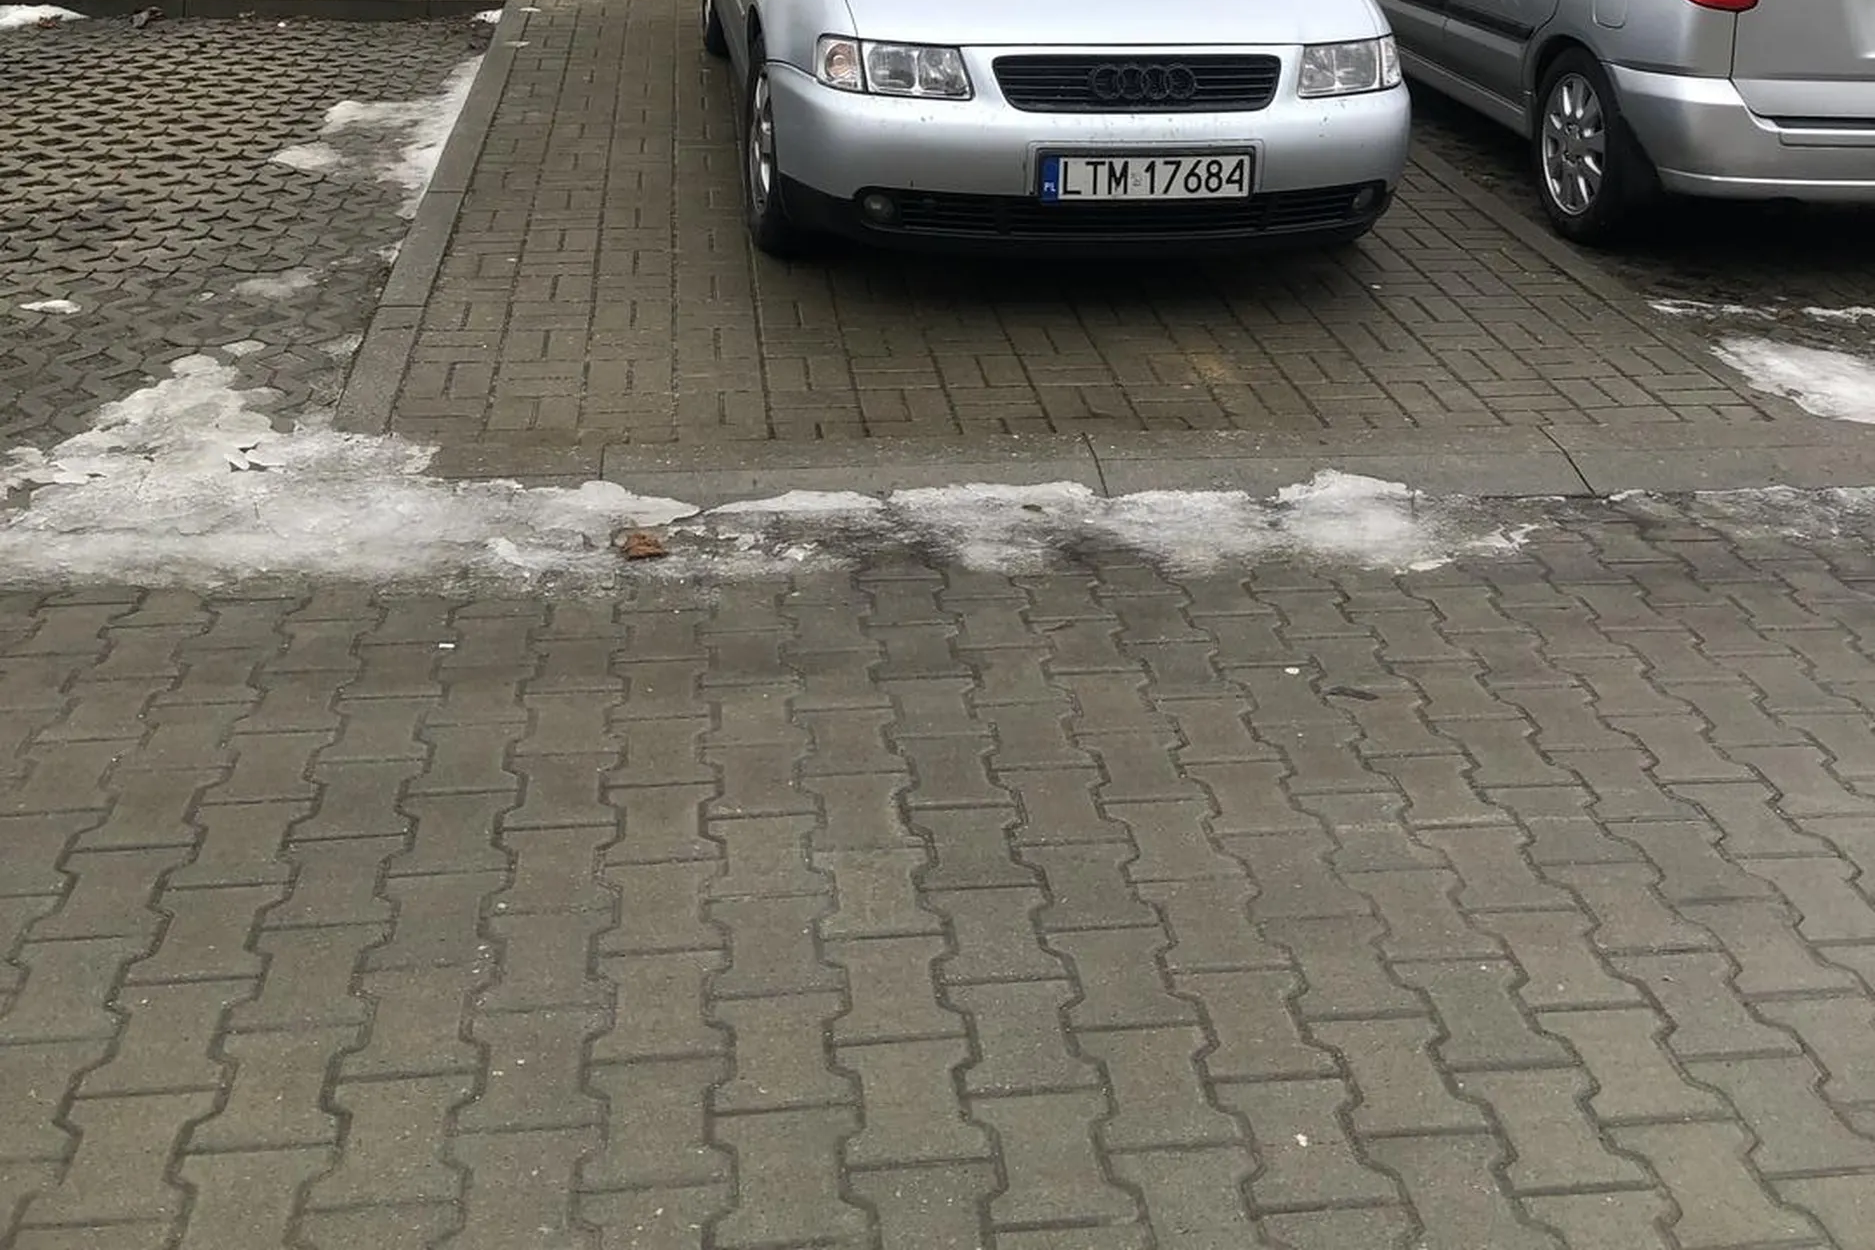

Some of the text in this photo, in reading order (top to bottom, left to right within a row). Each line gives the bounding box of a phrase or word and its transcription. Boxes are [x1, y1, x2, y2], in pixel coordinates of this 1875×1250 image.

[1044, 181, 1056, 192] PL
[1062, 158, 1245, 195] LTM 17684
